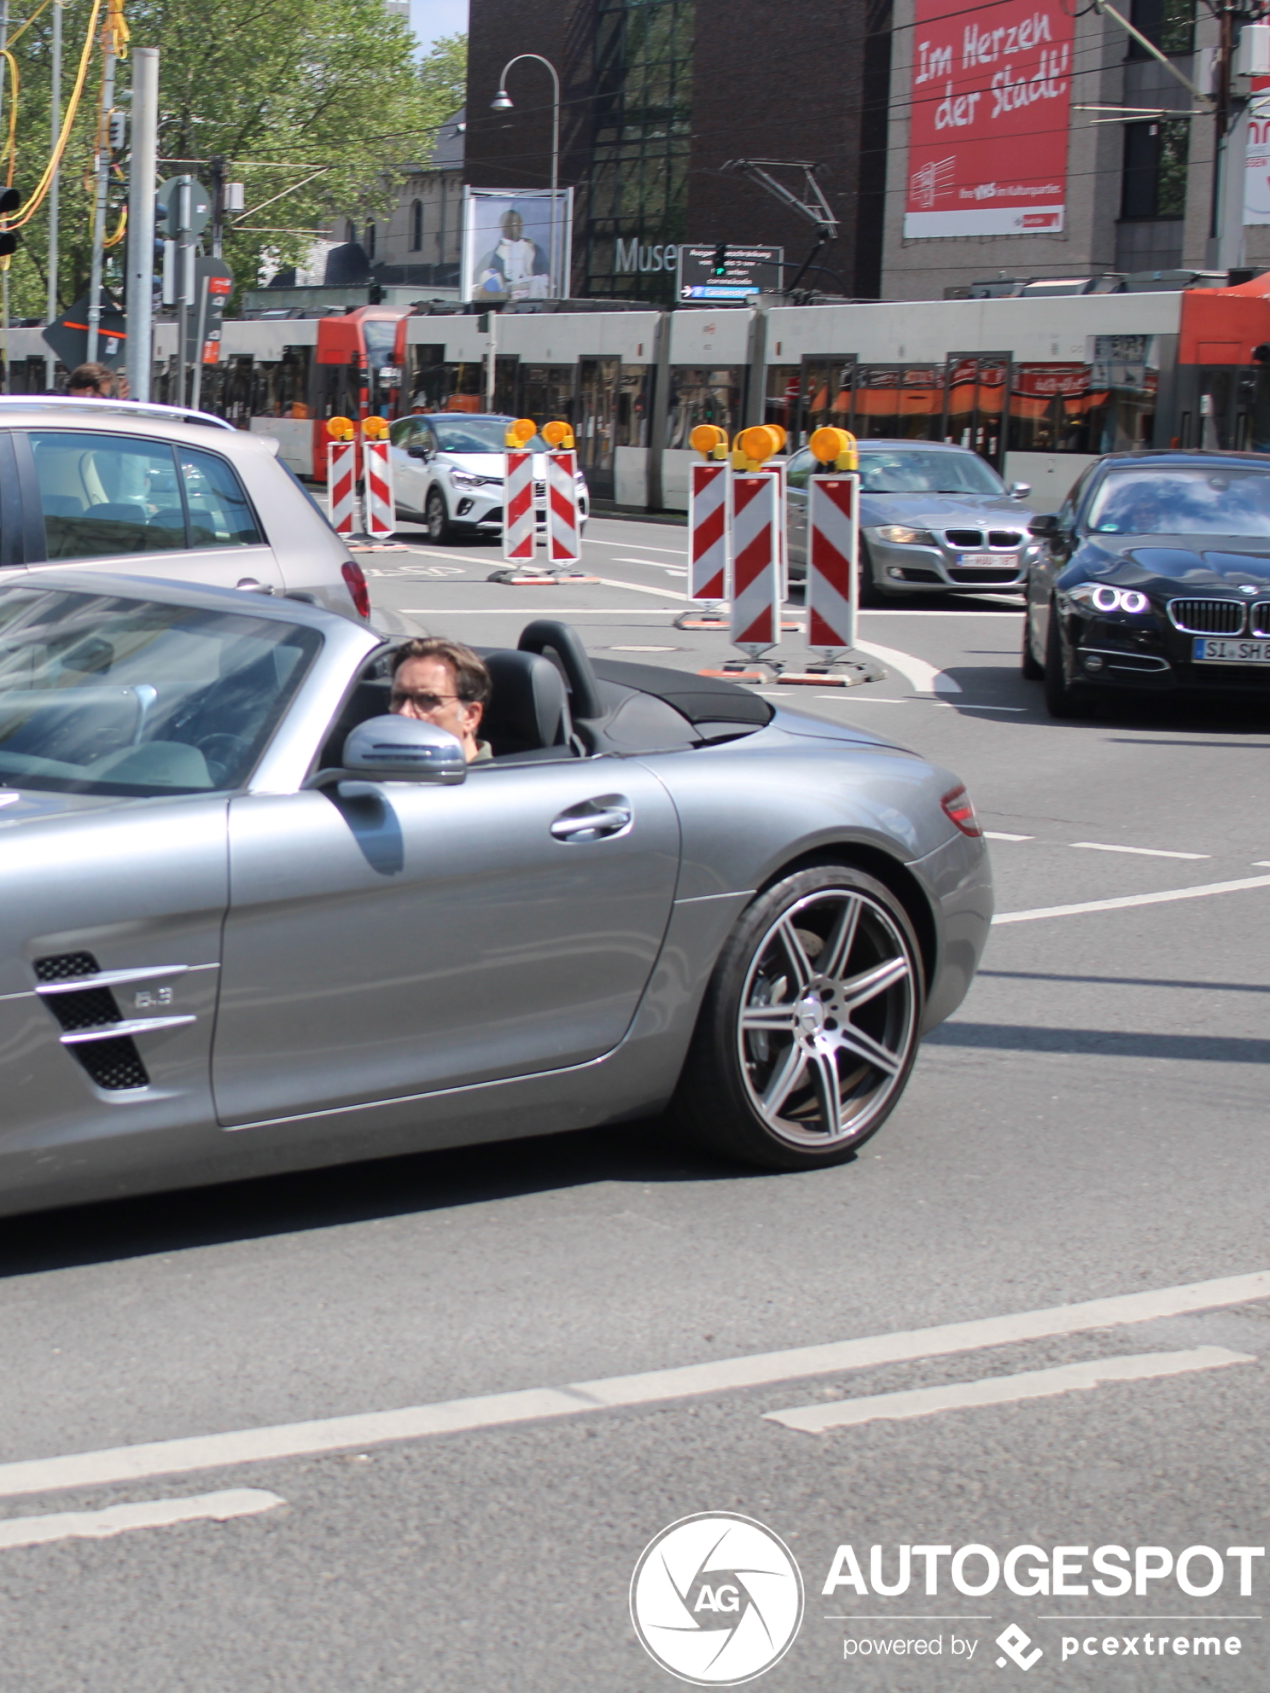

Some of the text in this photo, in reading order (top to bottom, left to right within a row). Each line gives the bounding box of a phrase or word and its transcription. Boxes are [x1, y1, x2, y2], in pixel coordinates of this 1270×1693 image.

[915, 12, 1051, 84] Im Herzen
[935, 43, 1068, 130] der Stadt!
[615, 237, 678, 273] Muse
[1206, 642, 1226, 657] SI
[1238, 643, 1261, 659] SH
